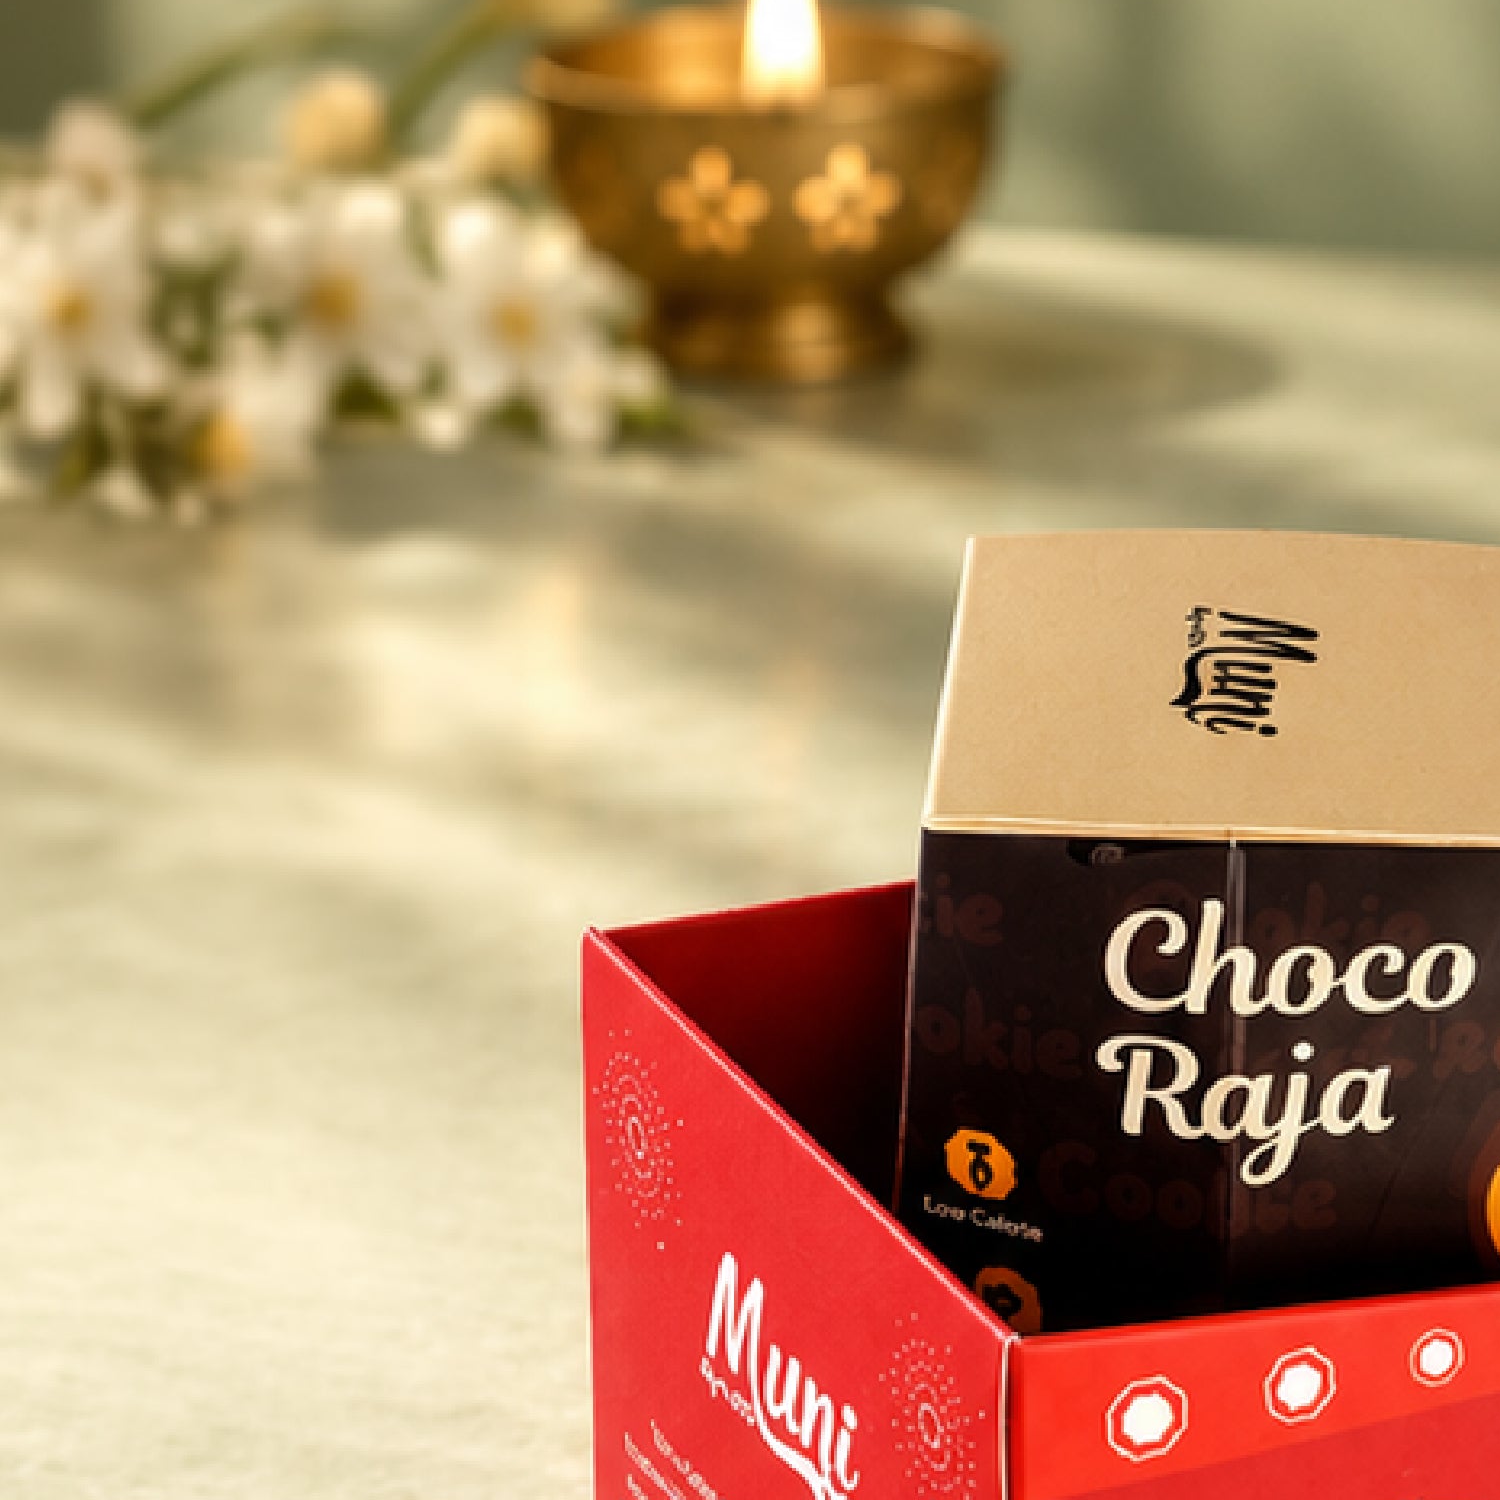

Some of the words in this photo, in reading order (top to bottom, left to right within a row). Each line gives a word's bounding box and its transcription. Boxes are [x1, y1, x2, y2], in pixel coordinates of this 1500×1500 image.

[1170, 610, 1320, 738] Muni
[1103, 895, 1477, 1017] Choco
[1096, 1035, 1394, 1186] Raja
